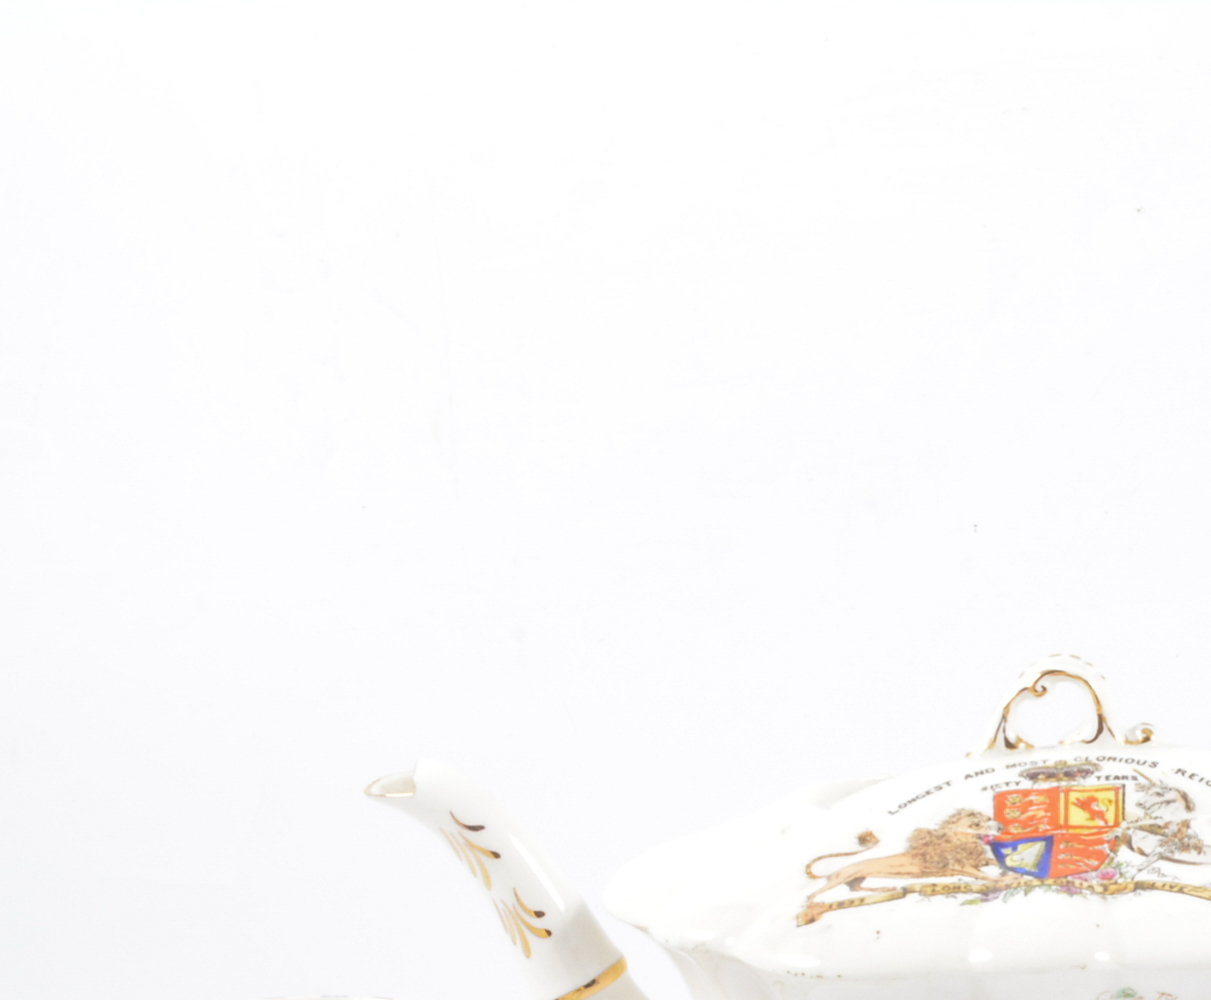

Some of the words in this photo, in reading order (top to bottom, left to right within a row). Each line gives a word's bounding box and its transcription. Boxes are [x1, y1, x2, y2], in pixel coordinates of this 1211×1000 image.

[964, 766, 995, 780] AND
[1005, 759, 1049, 770] MOST
[1095, 774, 1139, 782] YEARS
